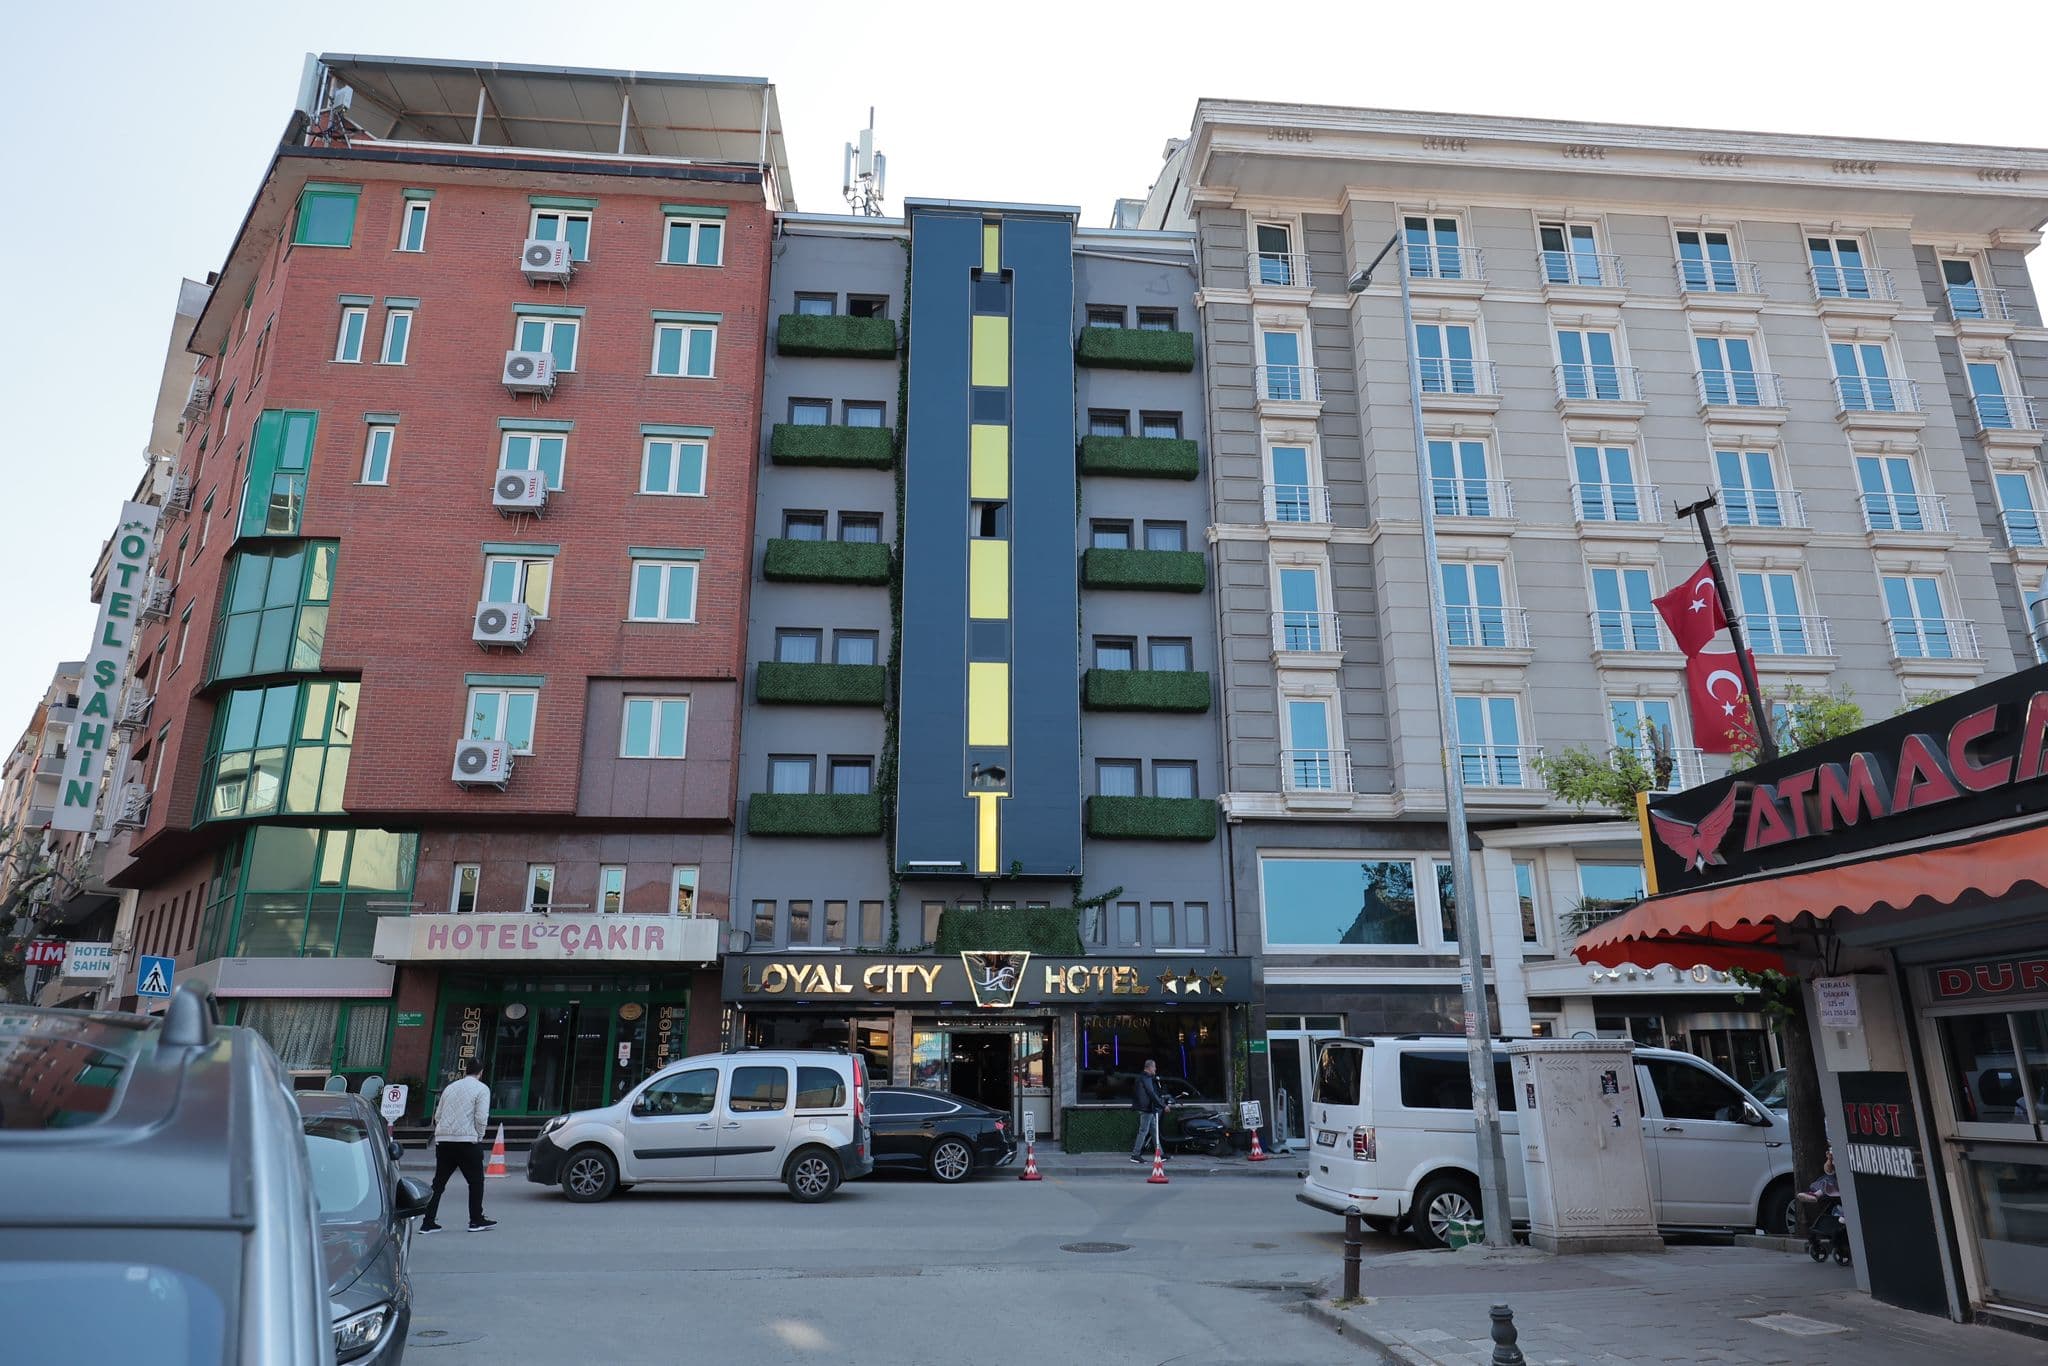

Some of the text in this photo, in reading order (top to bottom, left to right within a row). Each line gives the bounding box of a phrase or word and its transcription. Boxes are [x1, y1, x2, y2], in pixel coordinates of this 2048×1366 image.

[553, 248, 562, 267] VESTEL
[536, 359, 546, 379] VESTEL
[528, 477, 537, 499] VESTEL
[102, 535, 146, 648] OTEL
[510, 611, 519, 635] VESTEL
[490, 747, 500, 773] VESTEL
[74, 946, 113, 957] HOTEL
[427, 922, 665, 956] HOTEL ÖZ ÇAKIR
[72, 960, 111, 972] ŞAHİN
[743, 963, 855, 994] LOYAL
[863, 963, 943, 994] CITY
[1045, 965, 1150, 995] HOTEL
[458, 1007, 481, 1071] HOTEL
[656, 1006, 673, 1069] HOTEL
[1845, 1102, 1901, 1137] TOST
[1846, 1143, 1917, 1178] HAMBURGER
